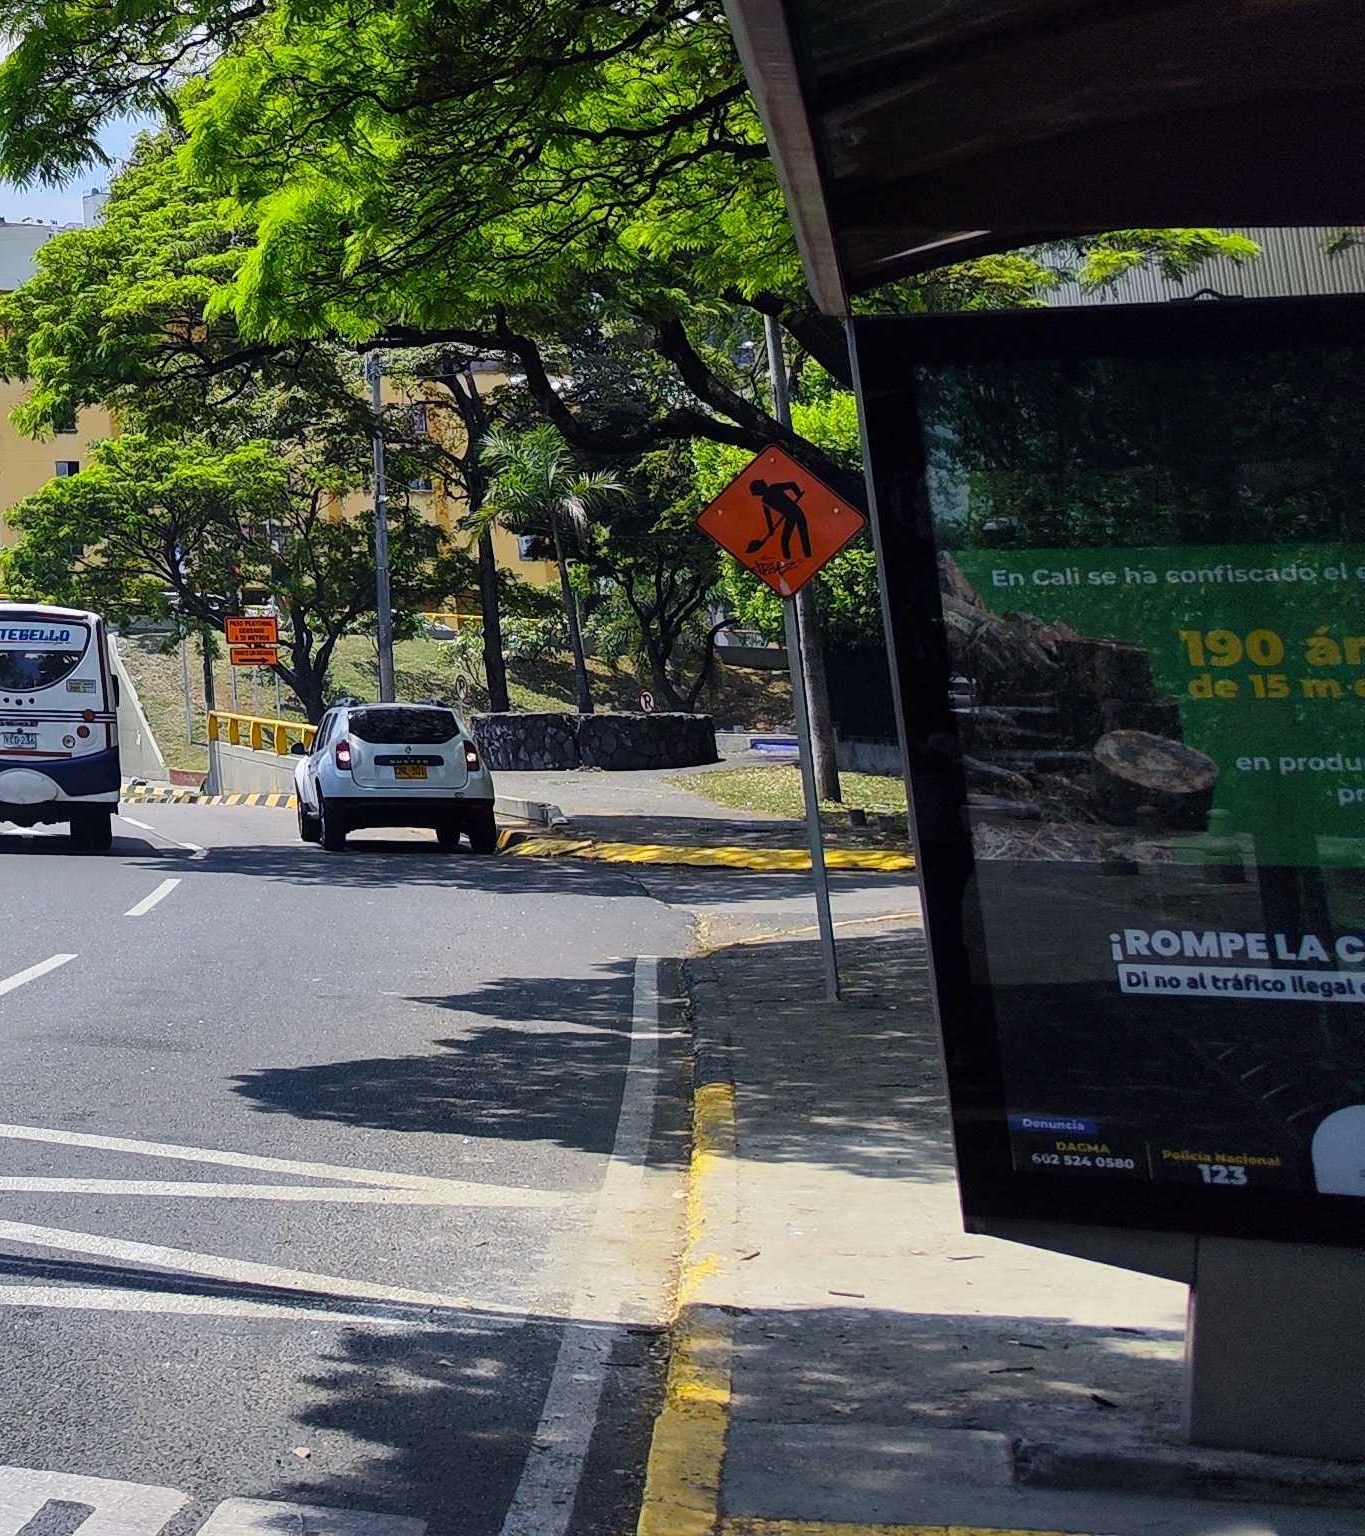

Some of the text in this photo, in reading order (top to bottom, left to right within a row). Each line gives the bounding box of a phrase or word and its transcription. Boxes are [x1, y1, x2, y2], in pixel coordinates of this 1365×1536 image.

[991, 568, 1024, 586] En
[1032, 567, 1080, 586] Cali
[1088, 570, 1117, 585] se
[1124, 566, 1158, 584] ha
[1165, 563, 1316, 584] confiscado
[1323, 562, 1347, 581] el
[1179, 628, 1284, 667] 190
[1188, 673, 1238, 698] de
[1248, 673, 1289, 698] 15
[1301, 677, 1343, 698] m
[1235, 755, 1271, 770] en
[1109, 928, 1270, 961] ¡ROMPE
[1274, 933, 1331, 962] LA
[1125, 970, 1149, 988] Di
[1154, 974, 1181, 989] no
[1186, 972, 1207, 990] al
[1211, 972, 1286, 993] tráfico
[1022, 1117, 1085, 1131] Denuncia
[1055, 1140, 1111, 1155] DAGMA
[1031, 1152, 1061, 1166] 602
[1094, 1156, 1136, 1170] 0580
[1214, 1152, 1281, 1167] Nacional
[1197, 1163, 1248, 1185] 123
